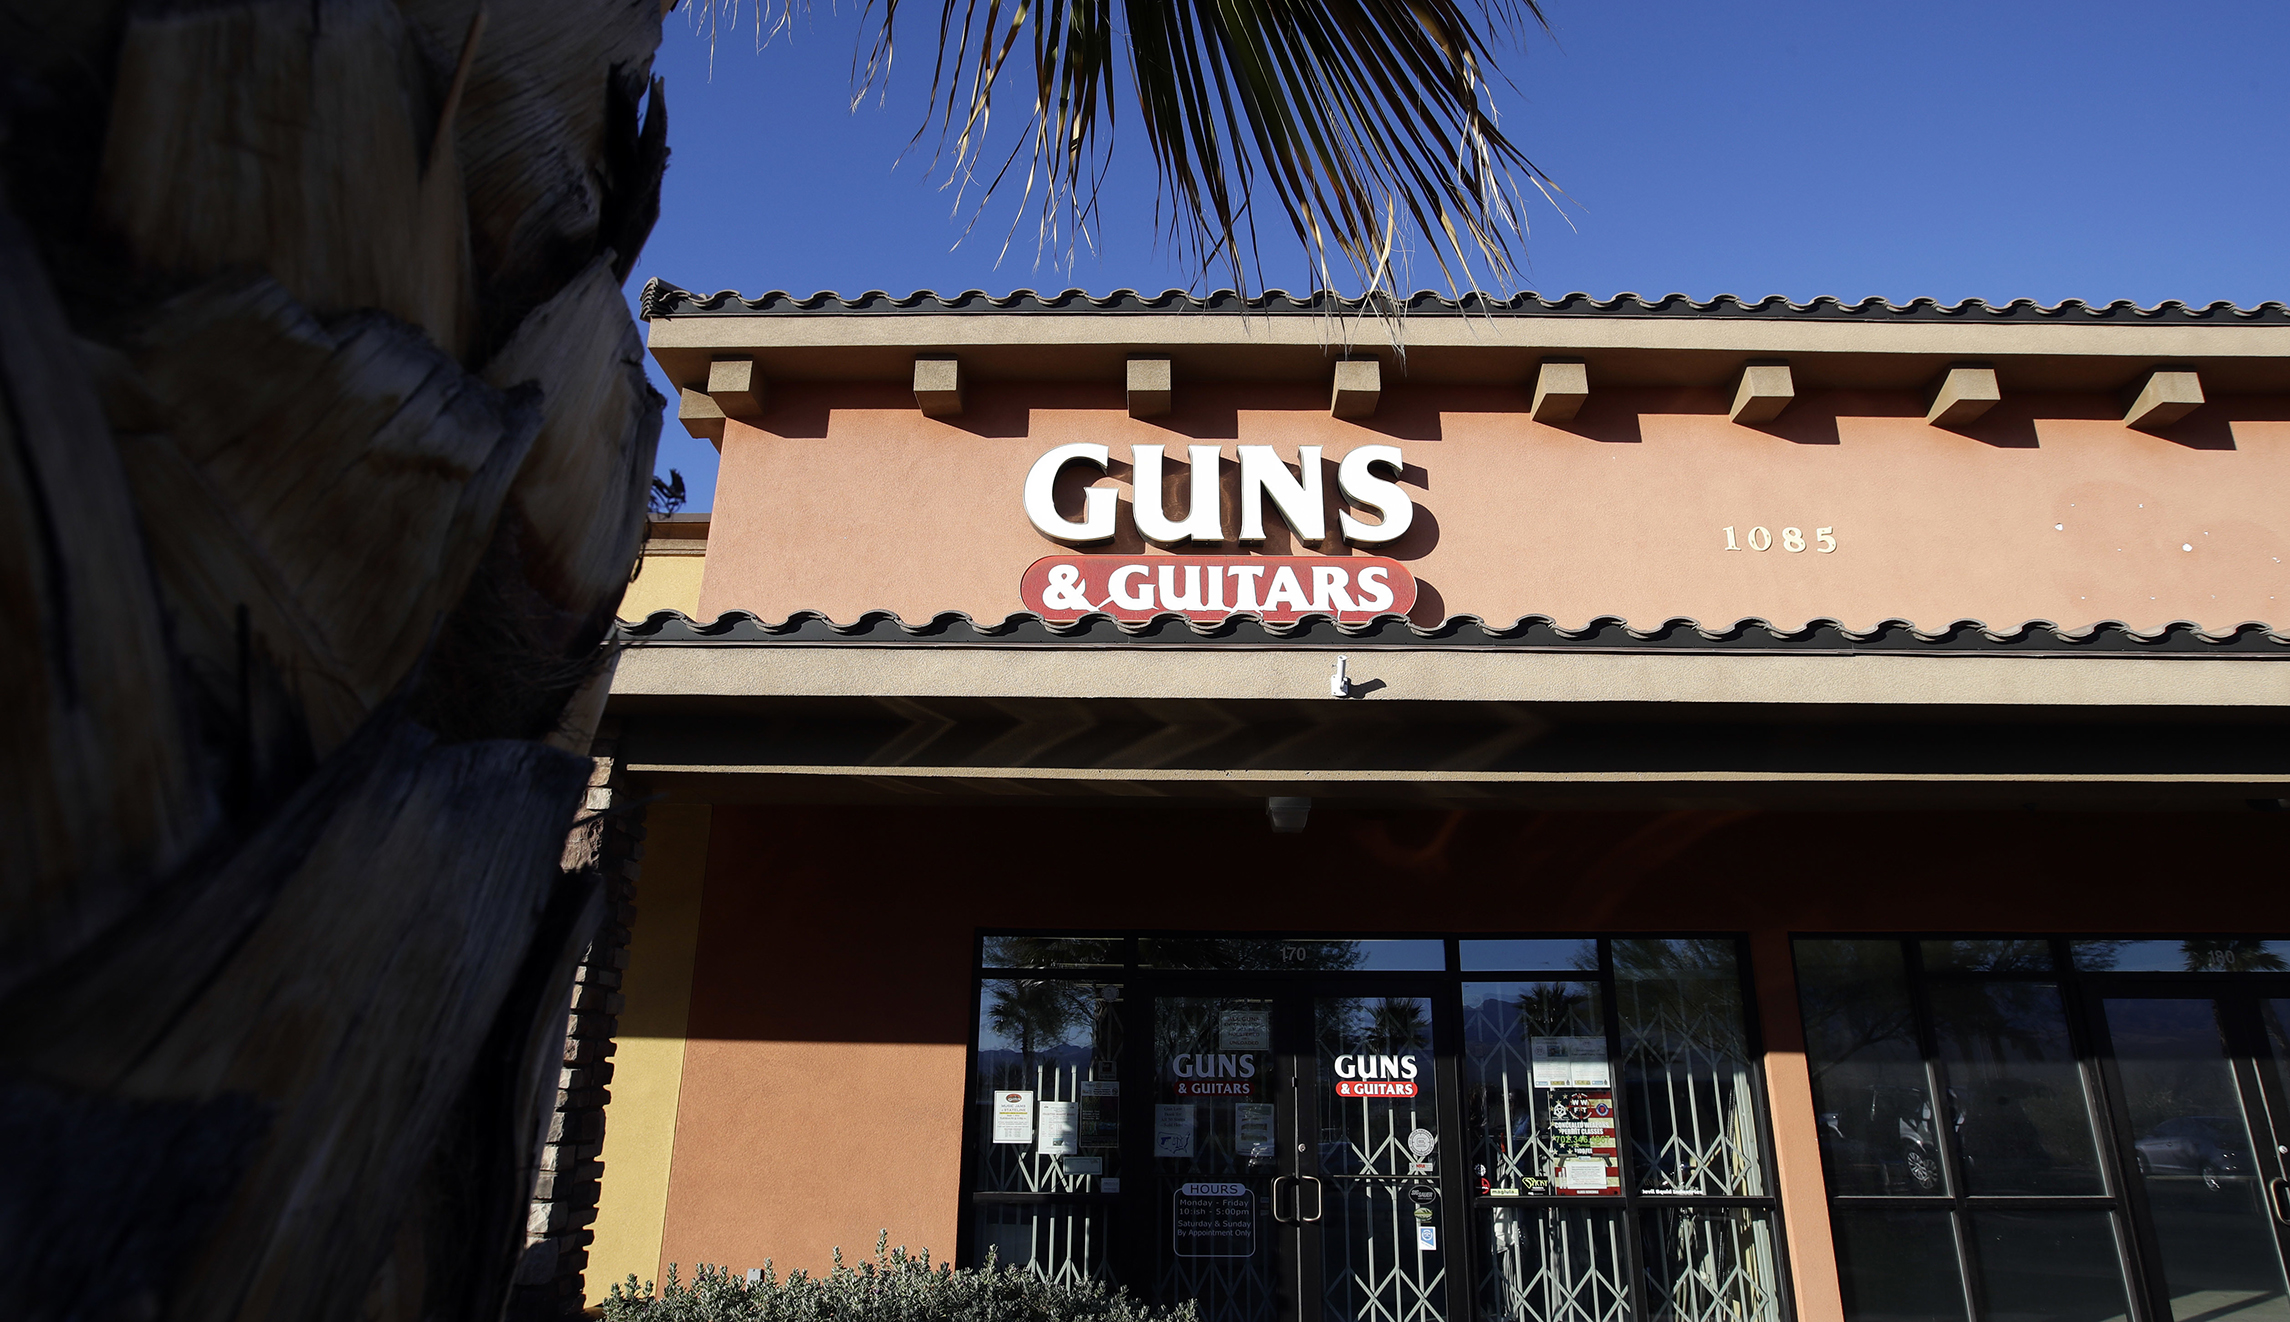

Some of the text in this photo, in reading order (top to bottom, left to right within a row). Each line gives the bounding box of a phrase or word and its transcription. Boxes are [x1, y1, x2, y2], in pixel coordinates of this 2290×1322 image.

[1022, 442, 1413, 547] GUNS
[1722, 526, 1838, 553] 1085
[1042, 564, 1395, 612] & GUITARS
[1280, 946, 1306, 961] 170
[2207, 950, 2236, 965] 180
[1172, 1053, 1255, 1078] GUNS
[1334, 1054, 1418, 1079] GUNS
[1178, 1083, 1250, 1094] & GUITARS
[1340, 1083, 1413, 1095] & GUITARS
[1190, 1184, 1238, 1195] HOURS
[1179, 1199, 1213, 1207] Monday
[1222, 1199, 1249, 1207] Friday
[1215, 1208, 1250, 1216] 5:00pm
[1177, 1220, 1212, 1228] Saturday
[1222, 1220, 1252, 1228] Sunday
[1177, 1229, 1252, 1237] By Appointment Only
